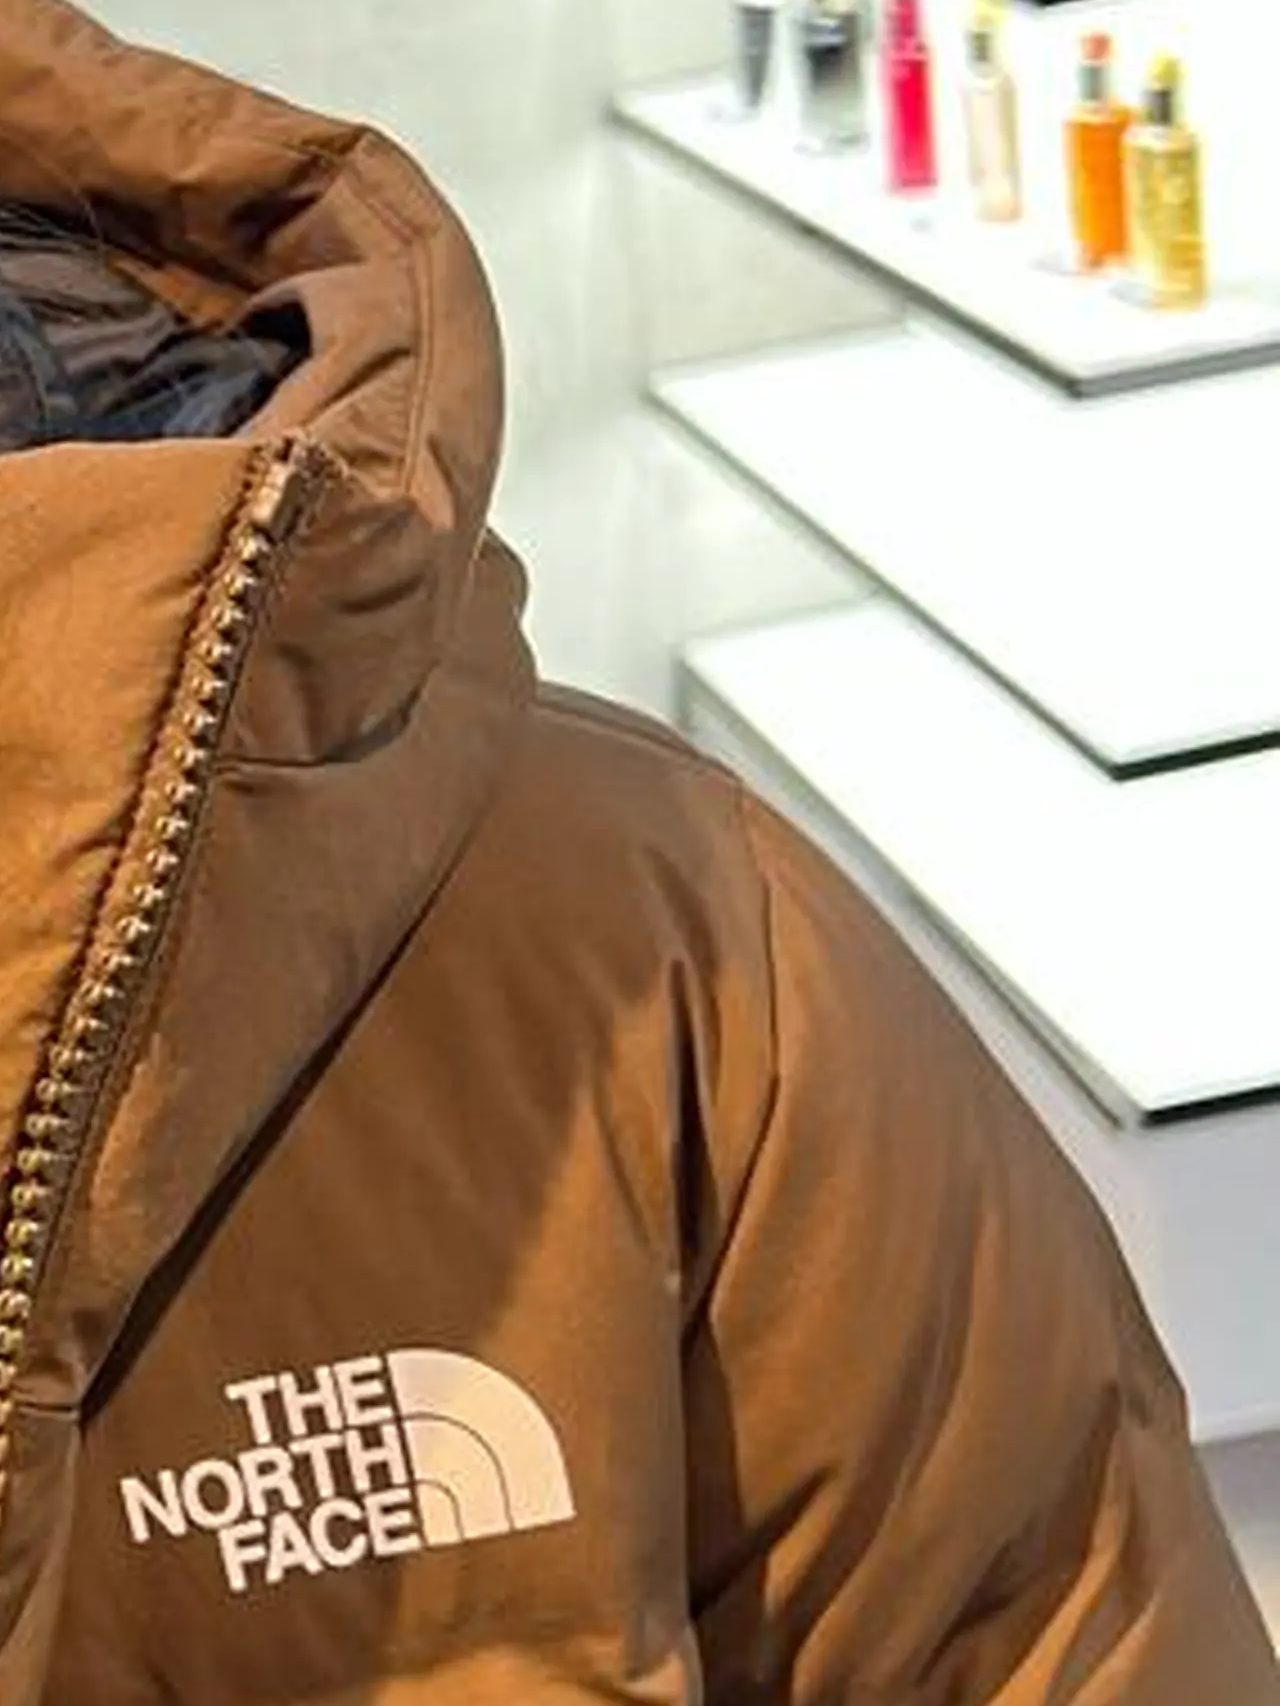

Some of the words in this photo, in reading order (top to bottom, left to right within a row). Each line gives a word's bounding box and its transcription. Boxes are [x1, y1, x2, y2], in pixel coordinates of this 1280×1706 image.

[225, 1356, 393, 1444] THE
[120, 1423, 408, 1543] NORTH
[217, 1489, 421, 1591] FACE
